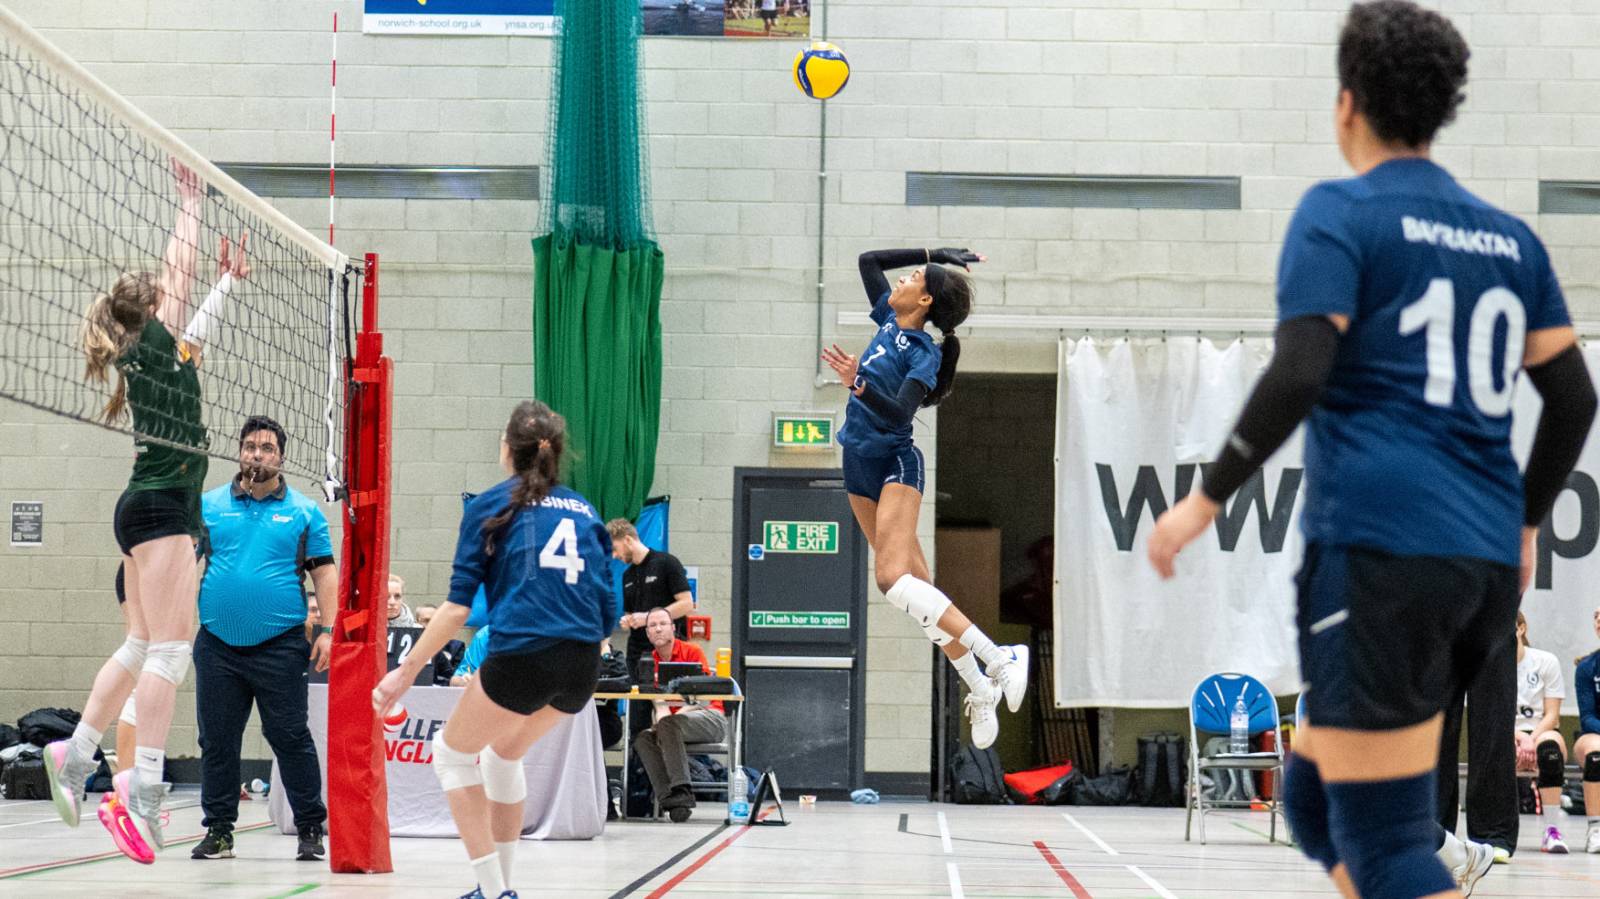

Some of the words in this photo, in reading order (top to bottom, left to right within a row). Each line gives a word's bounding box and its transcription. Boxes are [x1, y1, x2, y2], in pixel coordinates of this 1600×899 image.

[378, 16, 481, 29] norwich-school.org.uk
[862, 344, 886, 366] 7
[1398, 277, 1527, 418] 10
[797, 525, 829, 537] FIRE
[539, 518, 585, 584] 4
[797, 538, 830, 549] EXIT
[767, 614, 790, 624] Push
[792, 614, 807, 624] bar
[810, 615, 821, 624] to
[822, 616, 846, 626] open
[398, 633, 412, 665] 2
